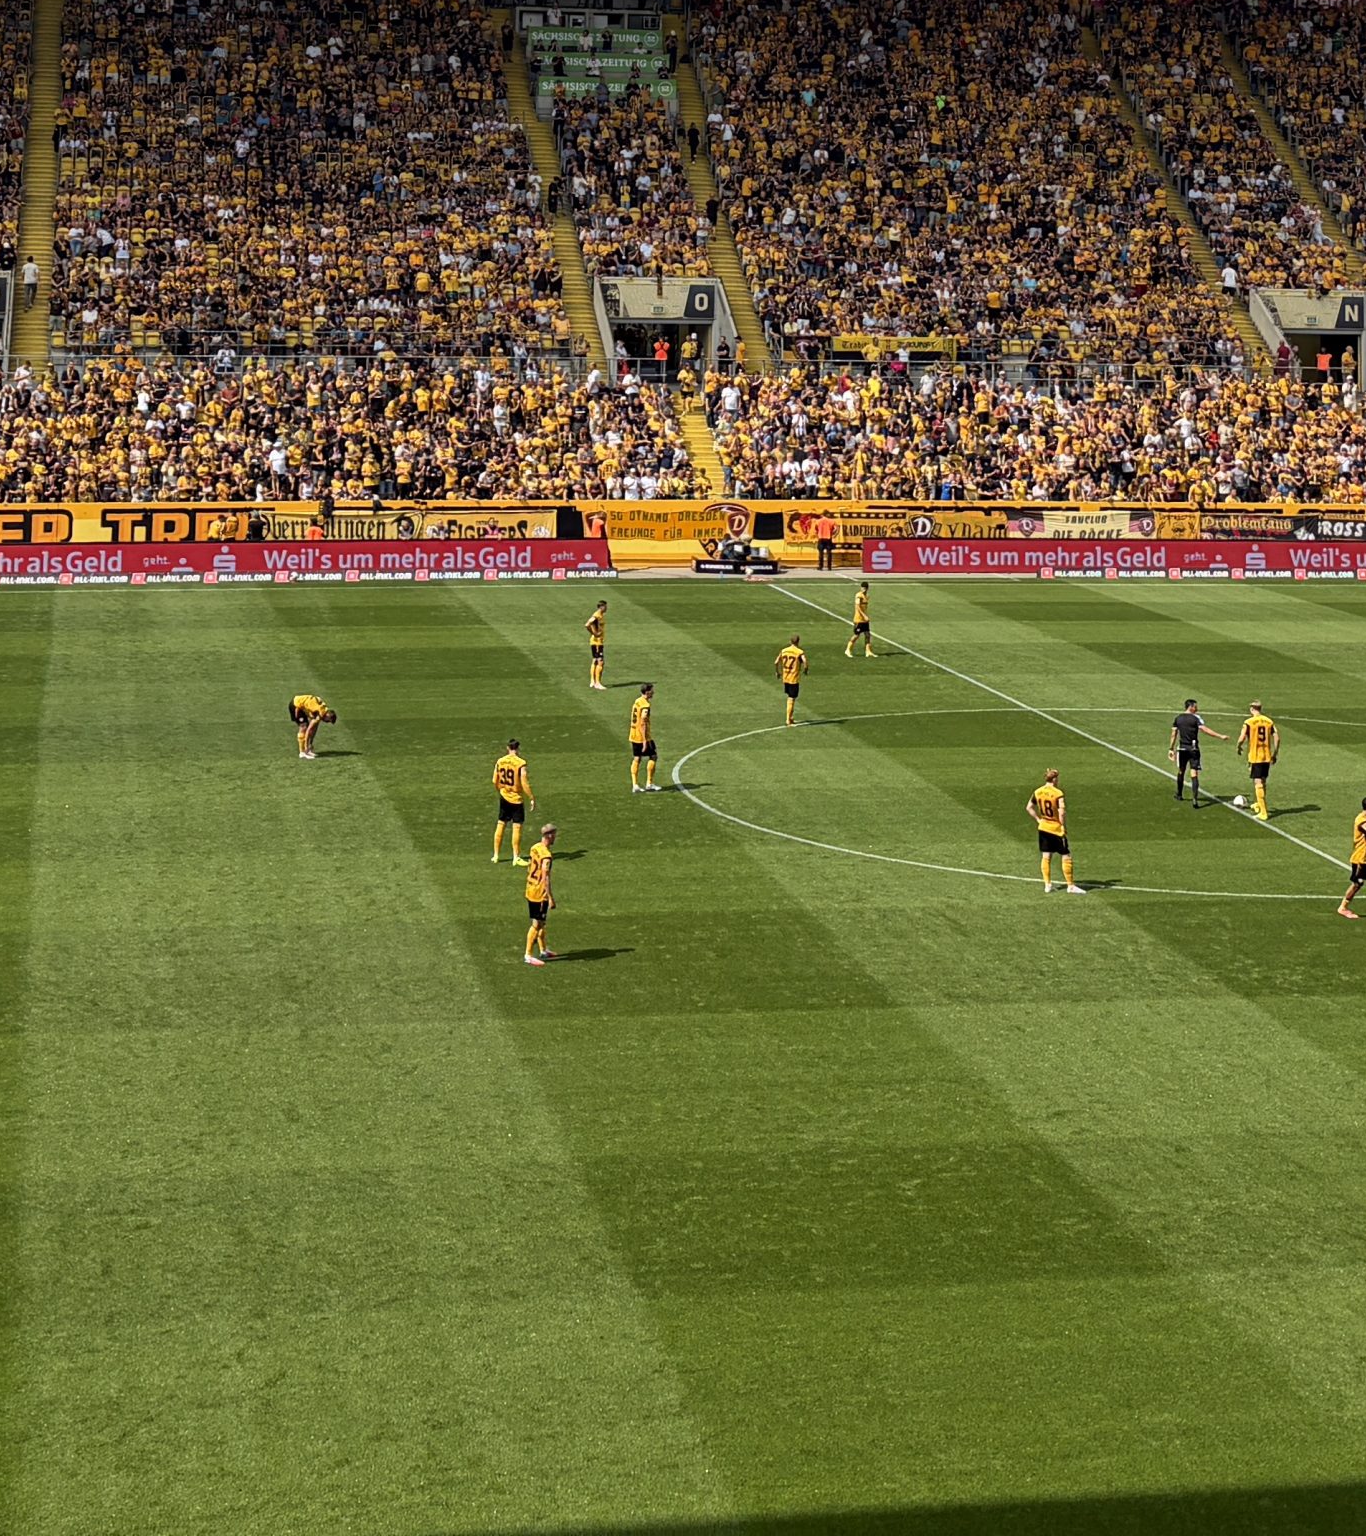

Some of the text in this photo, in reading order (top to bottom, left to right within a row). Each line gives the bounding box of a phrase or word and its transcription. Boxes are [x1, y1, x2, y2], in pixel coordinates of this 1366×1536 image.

[694, 292, 709, 310] O
[1345, 305, 1359, 322] N
[610, 511, 725, 523] SG DYNAMO DRESDEN
[1065, 515, 1108, 524] FANCLUB
[610, 526, 724, 539] FREUNDE FÜR IMMER
[842, 524, 888, 537] RADEBERG
[27, 551, 66, 575] als
[64, 551, 124, 575] Geld
[264, 549, 332, 569] Weil's
[339, 554, 373, 568] um
[380, 548, 439, 569] mehr
[442, 547, 475, 568] als
[479, 546, 531, 569] Geld
[917, 546, 980, 565] Weil's
[987, 552, 1018, 565] um
[1027, 547, 1079, 566] mehr
[1083, 547, 1116, 566] als
[1115, 547, 1165, 566] Geld
[1290, 548, 1350, 569] Weil's
[1257, 726, 1266, 742] 9
[500, 767, 515, 786] 39
[1039, 798, 1054, 817] 18
